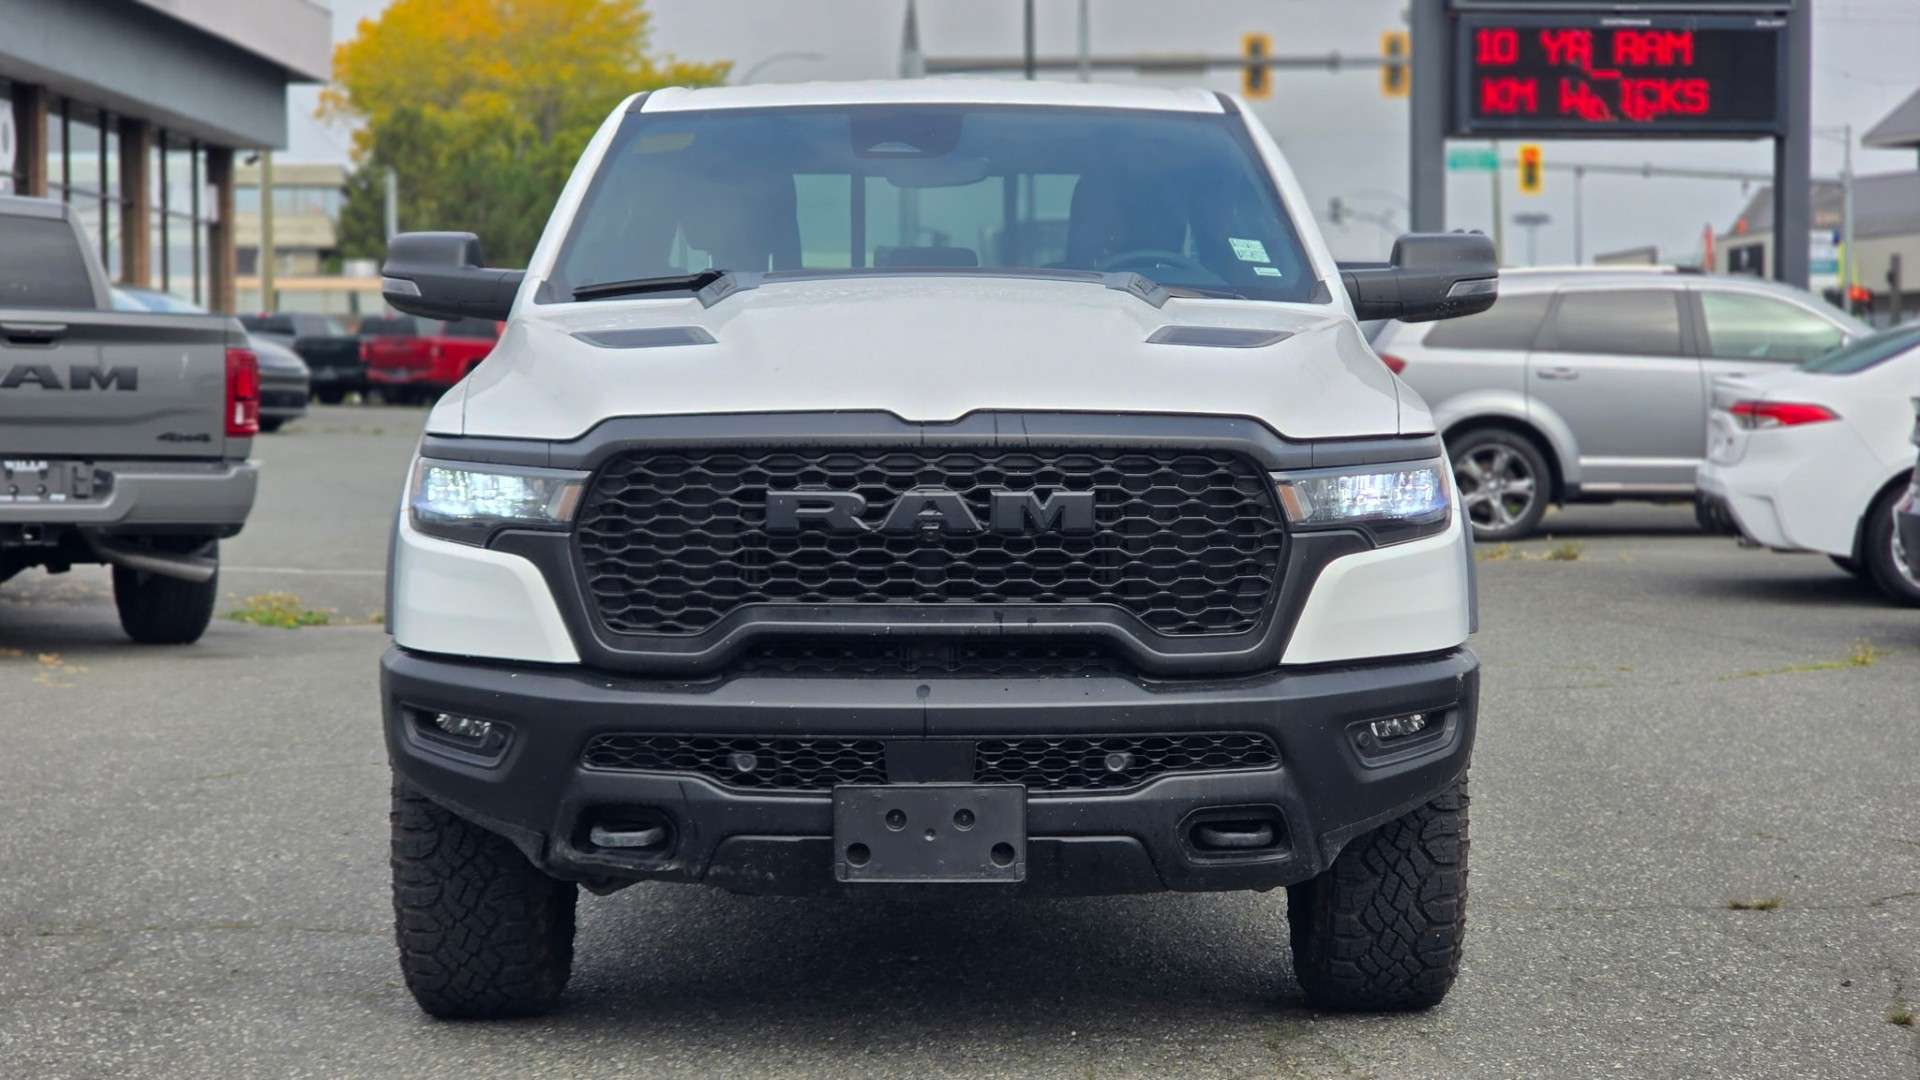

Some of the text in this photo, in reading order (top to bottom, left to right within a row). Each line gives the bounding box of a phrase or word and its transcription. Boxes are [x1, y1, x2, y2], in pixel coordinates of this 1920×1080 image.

[1477, 29, 1518, 65] 10
[1613, 31, 1694, 66] RAM
[0, 364, 138, 391] AM
[766, 490, 1096, 532] RAM
